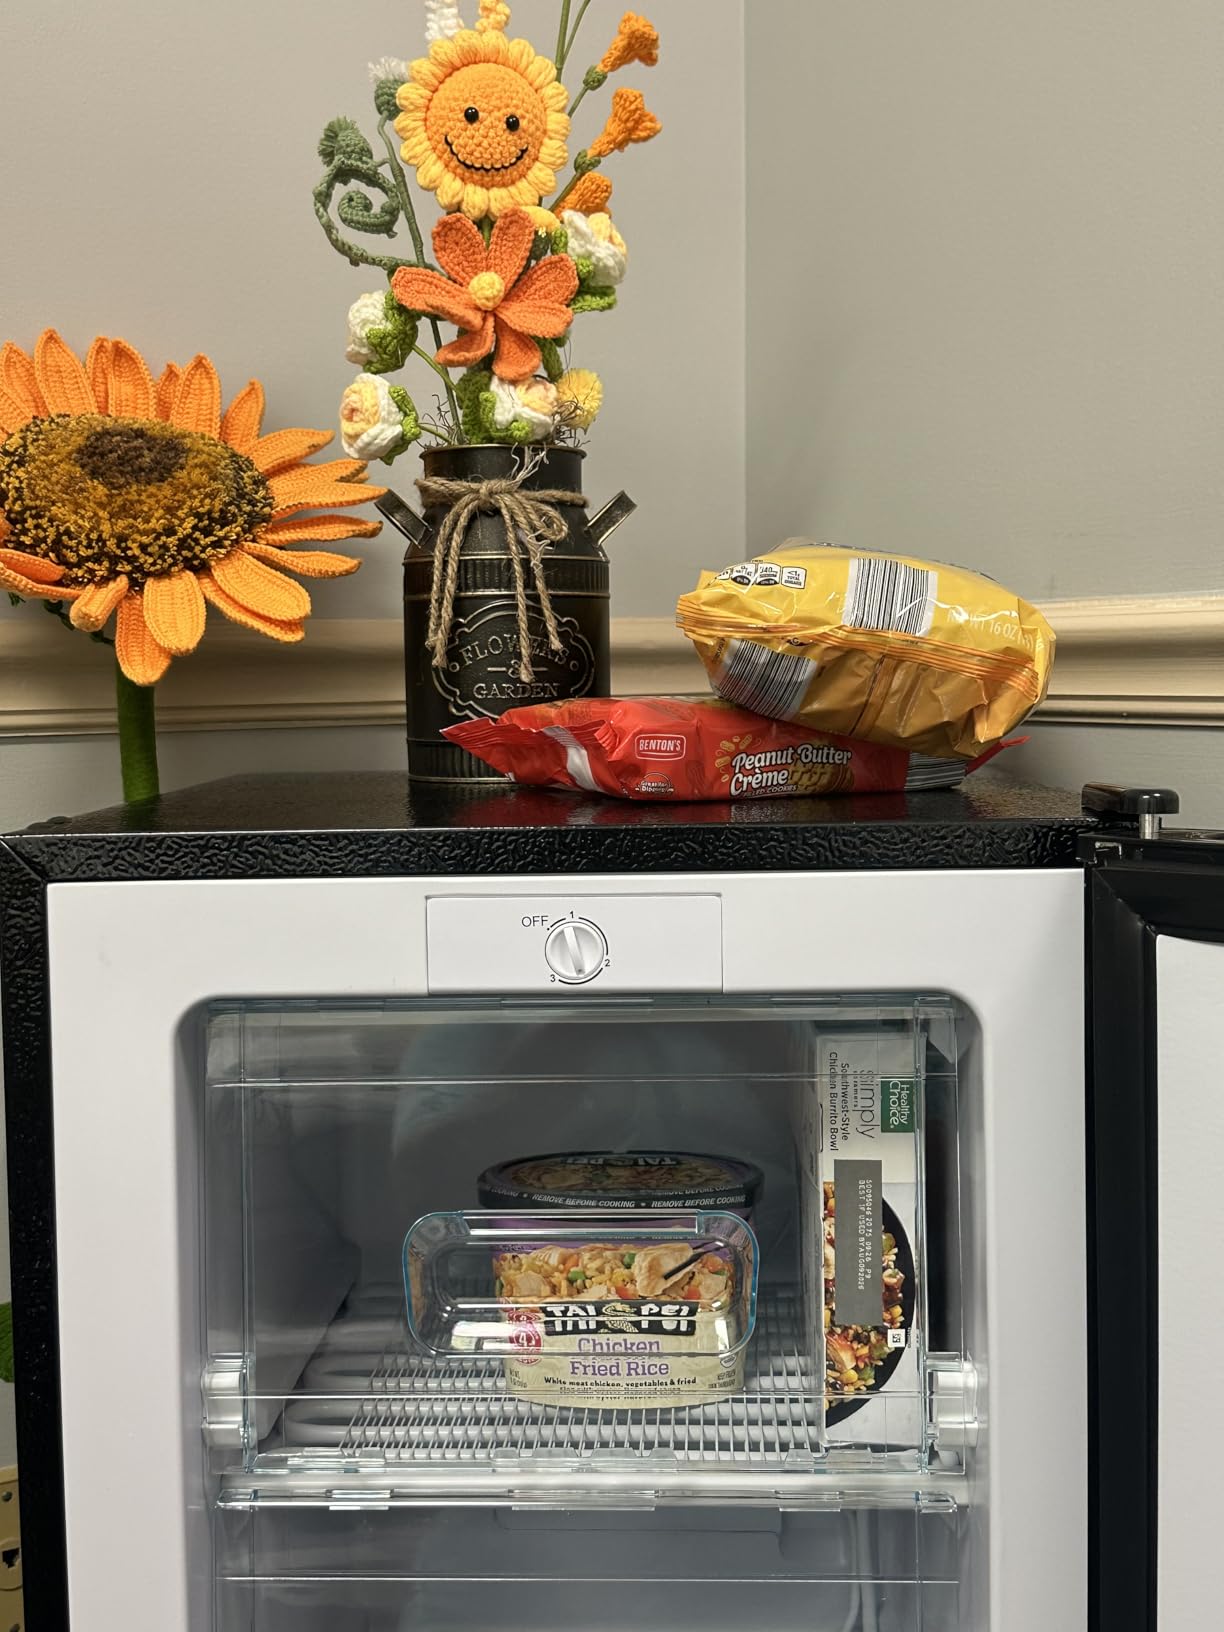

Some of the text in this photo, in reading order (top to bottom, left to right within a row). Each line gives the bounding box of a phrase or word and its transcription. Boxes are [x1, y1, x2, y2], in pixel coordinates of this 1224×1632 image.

[990, 620, 1001, 634] 16
[1003, 624, 1017, 639] OZ
[472, 682, 560, 699] GARDEN
[639, 739, 681, 752] BENTON'S
[732, 744, 852, 773] Peanut Butter
[730, 768, 789, 797] Crème
[766, 784, 798, 793] COOKIES
[521, 915, 549, 928] OFF
[569, 911, 575, 919] 1
[604, 959, 611, 967] 2
[550, 974, 556, 983] 3
[829, 1092, 838, 1125] Burrito
[852, 1070, 880, 1139] simply
[889, 1080, 900, 1125] Choice
[898, 1084, 911, 1125] Healthy
[829, 1127, 839, 1151] Bowl
[532, 1193, 636, 1208] REMOVE BEFORE COOKING
[651, 1194, 746, 1208] REMOVE BEFORE COOKING
[858, 1203, 865, 1211] IF
[858, 1237, 865, 1247] BY
[864, 1268, 872, 1279] P9
[546, 1303, 690, 1331] TAI PEI
[577, 1337, 661, 1354] Chicken
[570, 1361, 669, 1377] Fried Rice
[544, 1376, 567, 1385] White
[569, 1379, 588, 1387] meat
[590, 1379, 623, 1388] chicken,
[625, 1379, 668, 1387] vegetables
[677, 1376, 697, 1385] fried
